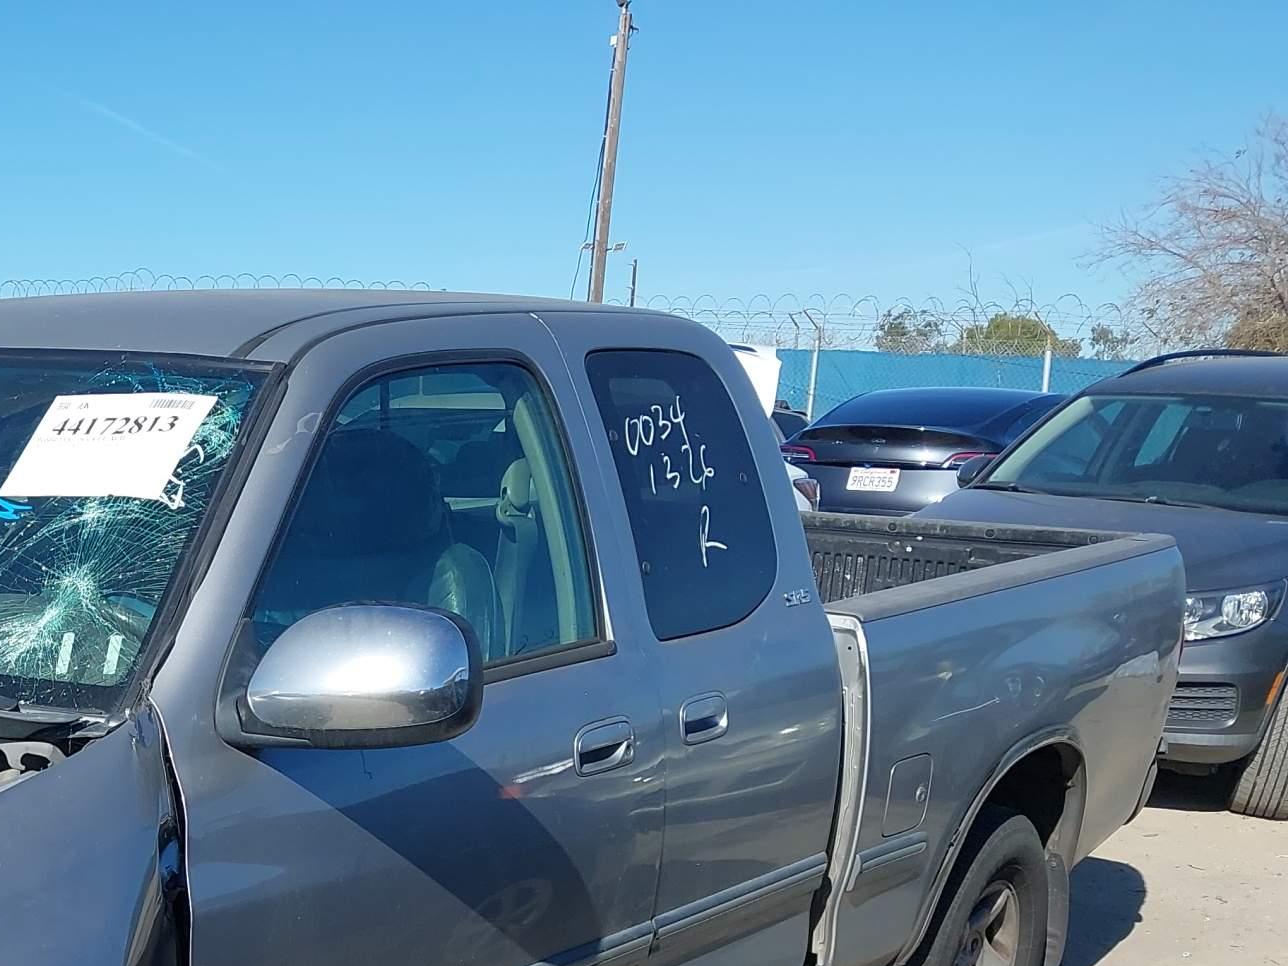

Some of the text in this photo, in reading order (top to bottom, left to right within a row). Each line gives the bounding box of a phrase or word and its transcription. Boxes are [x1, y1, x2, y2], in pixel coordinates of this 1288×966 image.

[52, 415, 179, 435] 44172813
[625, 396, 687, 455] 0034
[851, 475, 894, 488] 9RCR355
